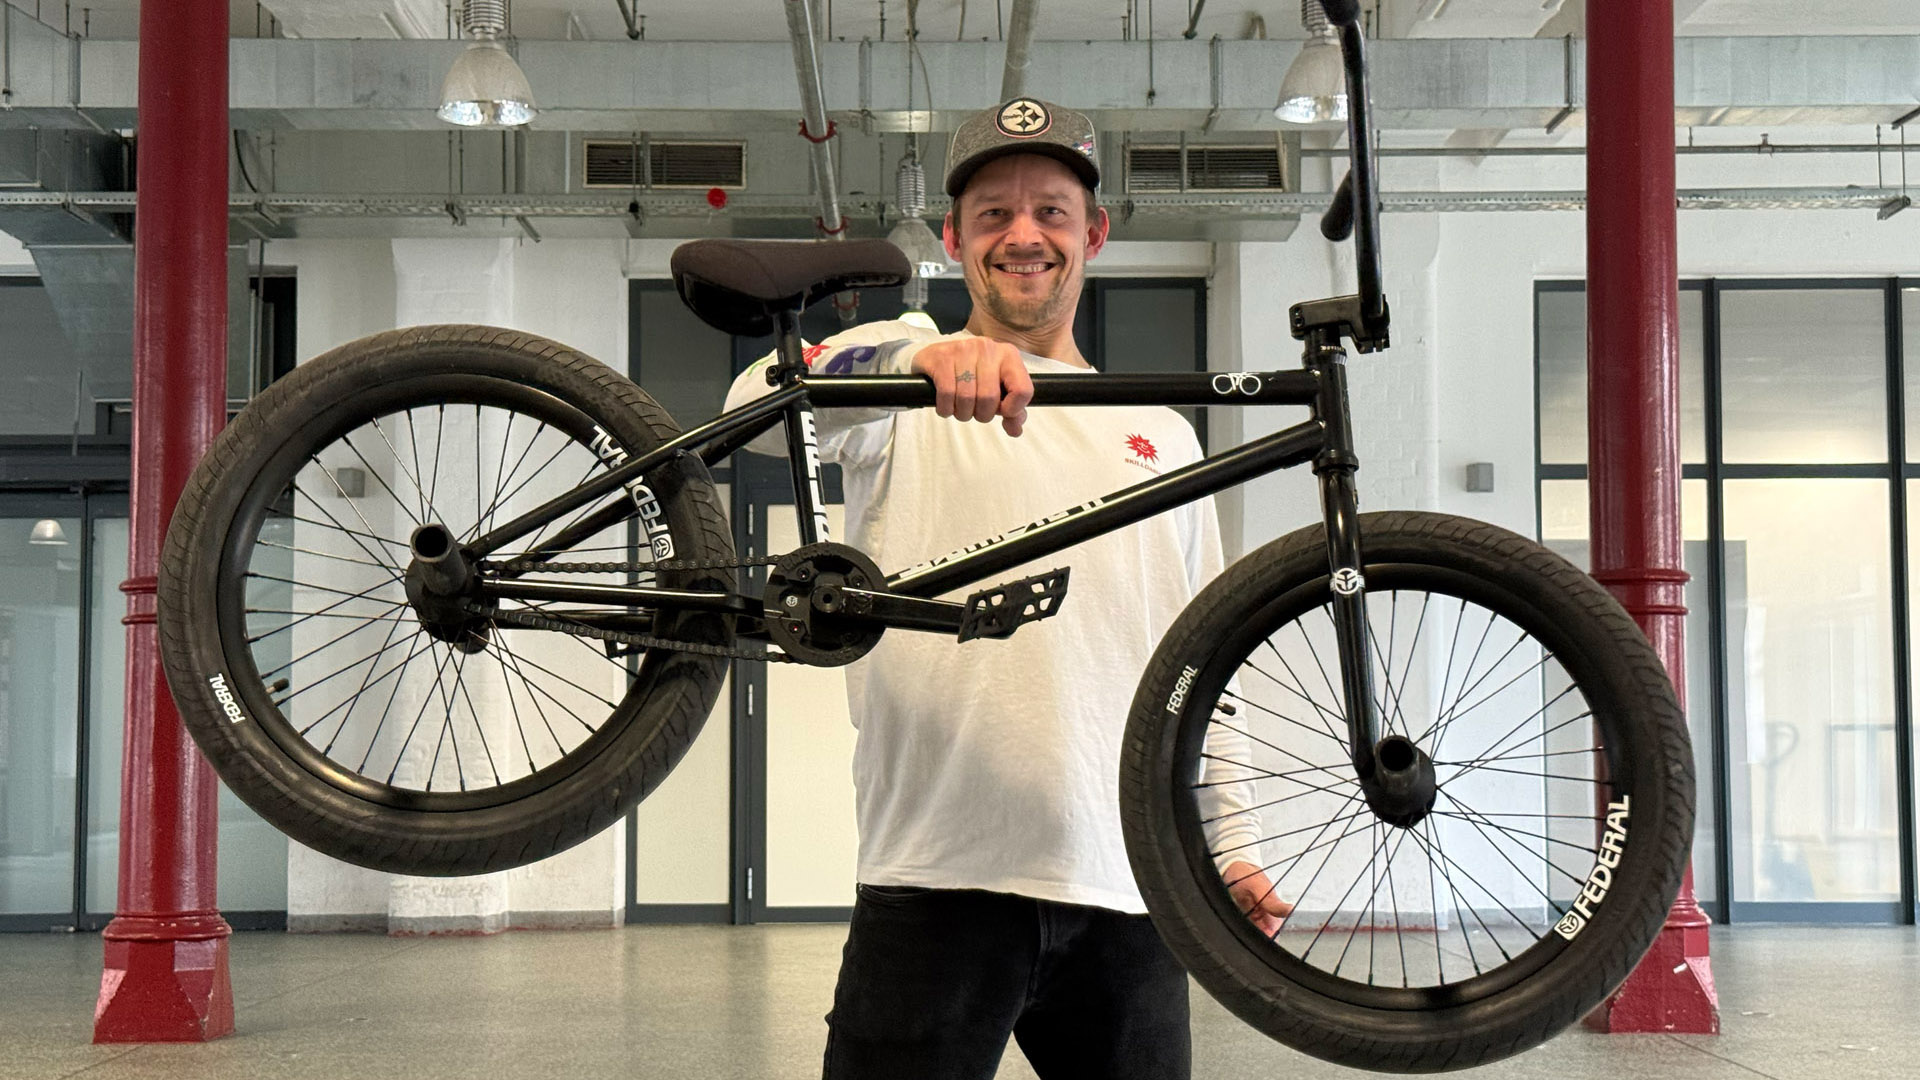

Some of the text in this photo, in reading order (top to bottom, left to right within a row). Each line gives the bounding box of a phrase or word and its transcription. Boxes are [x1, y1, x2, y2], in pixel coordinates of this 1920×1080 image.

[209, 672, 246, 724] FEDERAL
[1166, 665, 1198, 715] FEDERAL
[1573, 795, 1629, 919] FEDERAL
